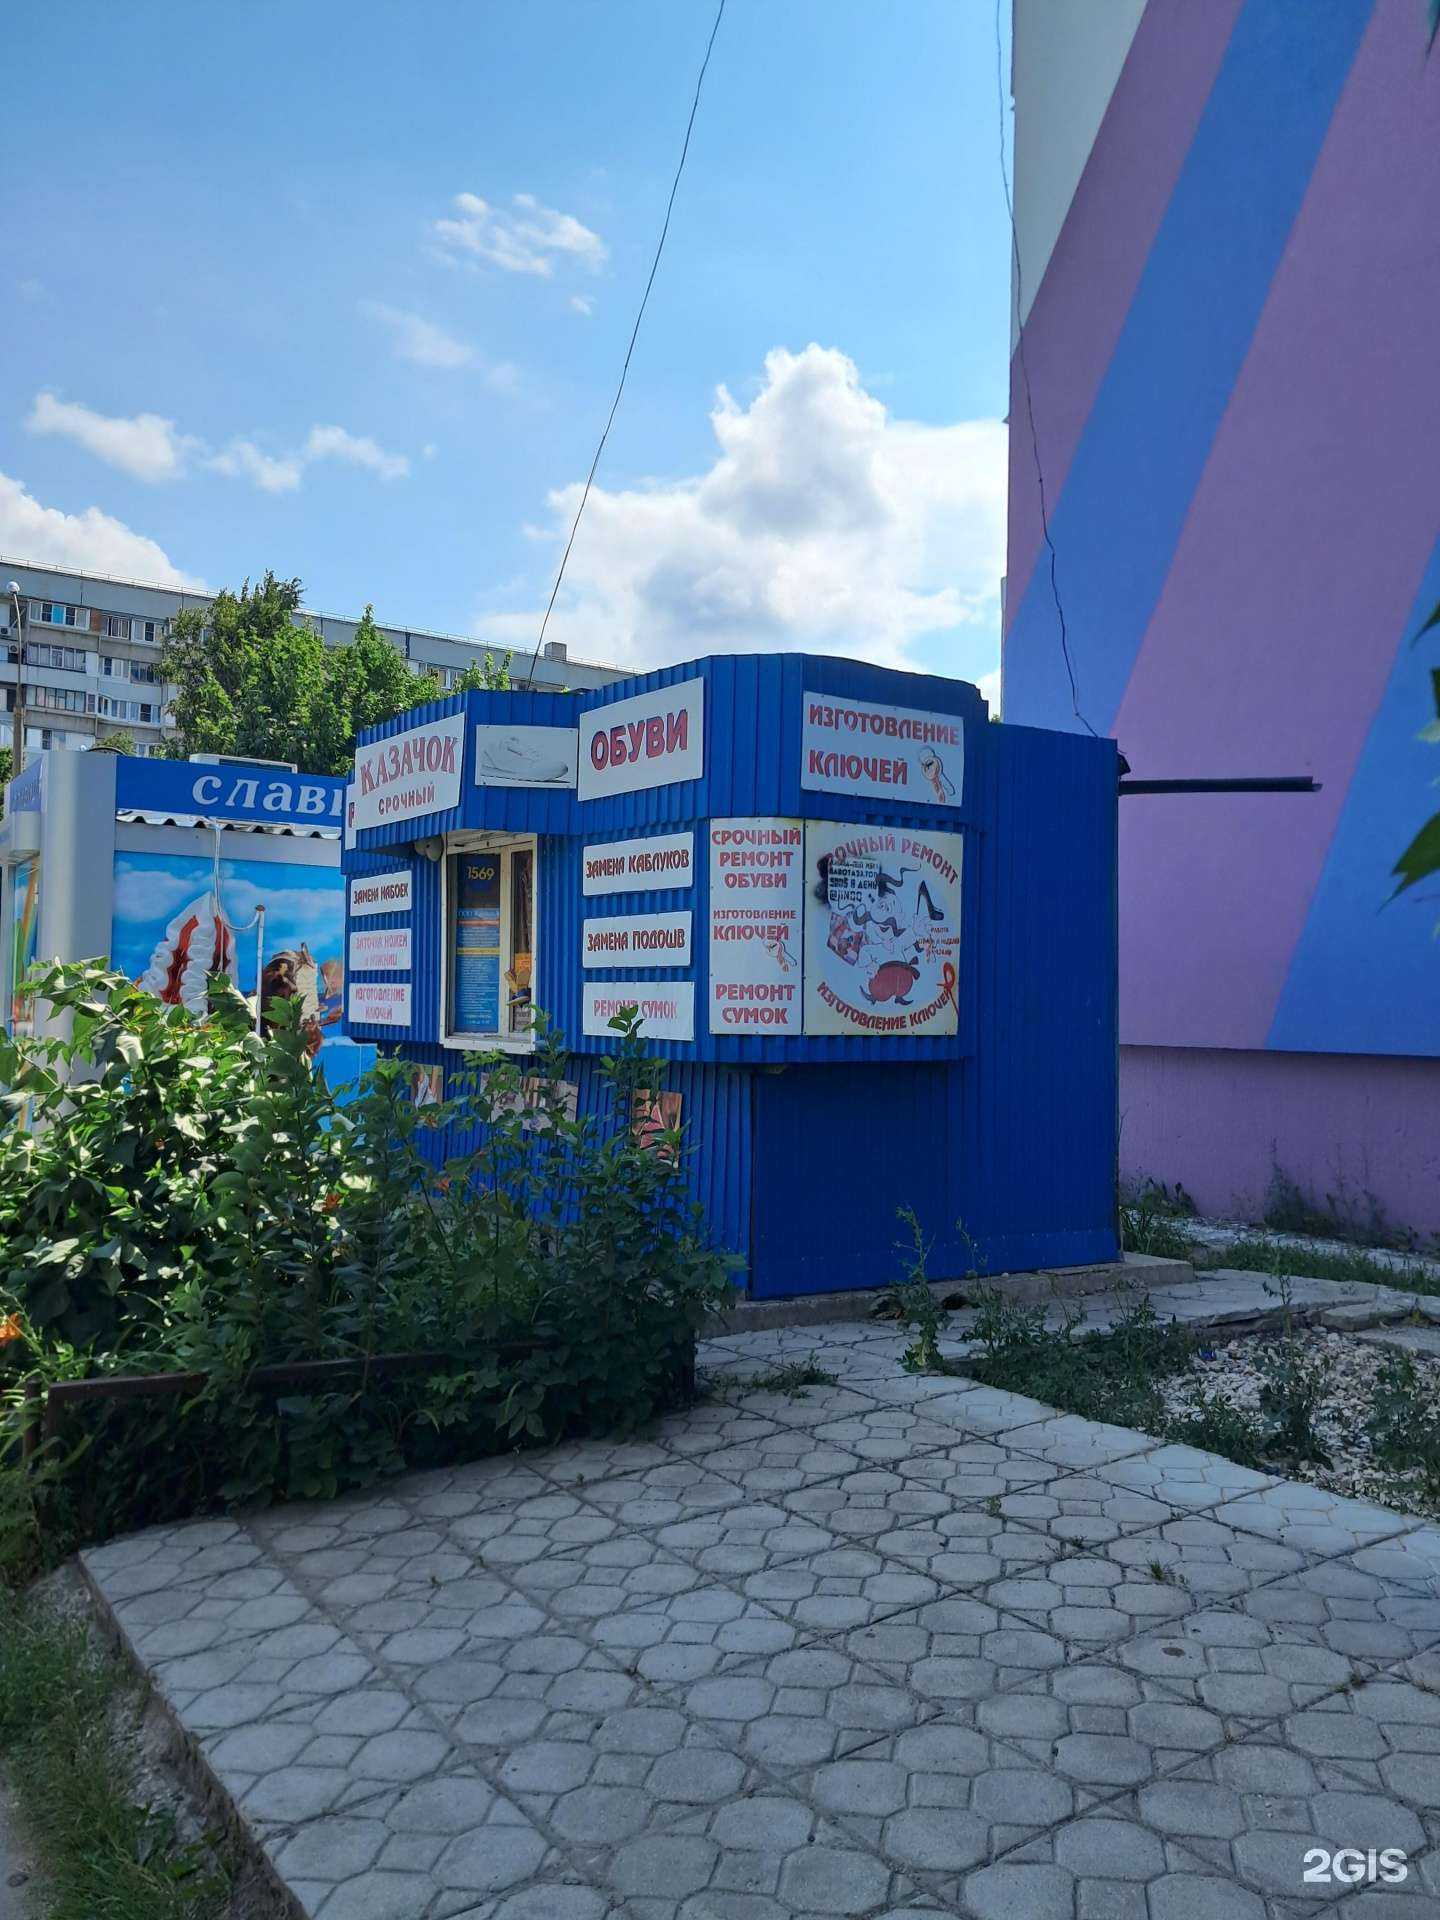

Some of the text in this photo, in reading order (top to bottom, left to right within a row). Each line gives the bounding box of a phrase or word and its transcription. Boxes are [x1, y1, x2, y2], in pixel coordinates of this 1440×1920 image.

[808, 703, 961, 746] ИЗГОТОВЛЕНИЕ
[591, 709, 688, 770] ОБУВИ
[360, 735, 457, 796] КАЗАЧОК
[808, 749, 908, 785] КЛЮЧЕЙ
[378, 781, 435, 816] СРОЧНЫЙ
[712, 827, 801, 846] СРОЧНЫЙ
[586, 849, 690, 880] ЗАМЕНА КАБЛУКОВ
[719, 851, 794, 868] РЕМОНТ
[901, 838, 959, 885] РЕМОНТ
[466, 866, 495, 881] 1569
[724, 872, 787, 888] ОБУВИ
[353, 882, 409, 905] ЗАМЕНА НАБОЕК
[713, 909, 797, 920] ИЗГОТОВЛЕНИЕ
[587, 928, 686, 952] ЗАМЕНА ПОДОШВ
[713, 923, 790, 942] КЛЮЧЕЙ
[355, 987, 405, 1003] ИЗГОТОВЛЕНИЕ
[716, 983, 796, 1002] РЕМОНТ
[641, 1000, 678, 1019] СУМОК
[722, 1007, 789, 1025] СУМОК
[817, 981, 907, 1031] ИЗГОТОВЛЕНИЕ
